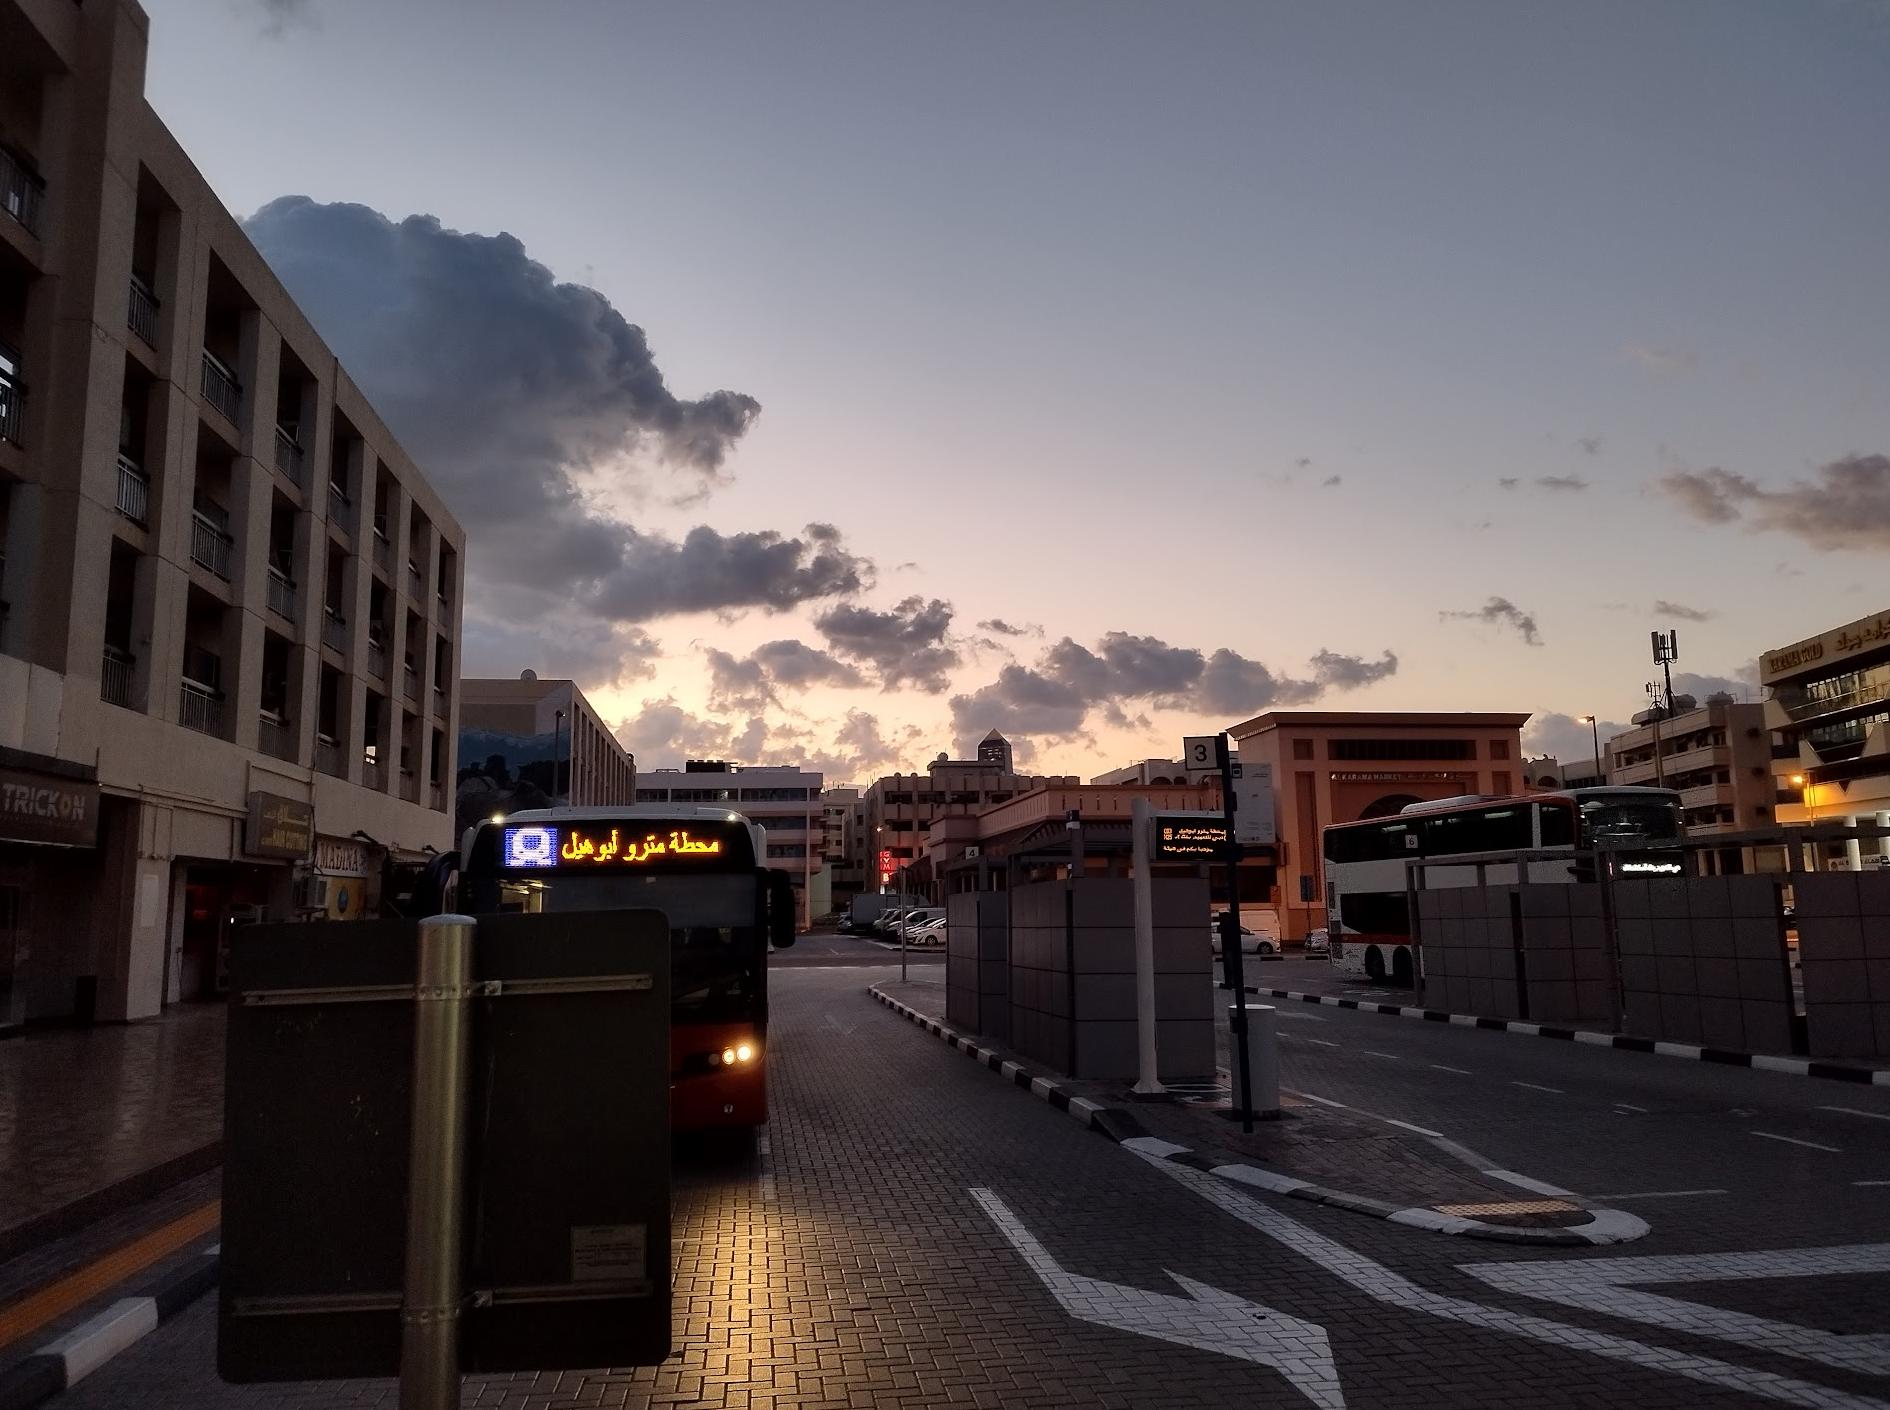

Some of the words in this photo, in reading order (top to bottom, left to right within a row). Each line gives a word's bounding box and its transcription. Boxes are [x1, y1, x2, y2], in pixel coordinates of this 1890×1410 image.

[1194, 744, 1207, 762] 3
[1341, 773, 1372, 781] KARAMA
[1373, 773, 1401, 781] MARKET
[561, 831, 594, 860] هيل
[593, 829, 618, 862] أبو
[622, 834, 665, 861] مترو
[669, 831, 719, 853] محطة
[969, 849, 976, 857] 4
[319, 841, 359, 872] MADINA
